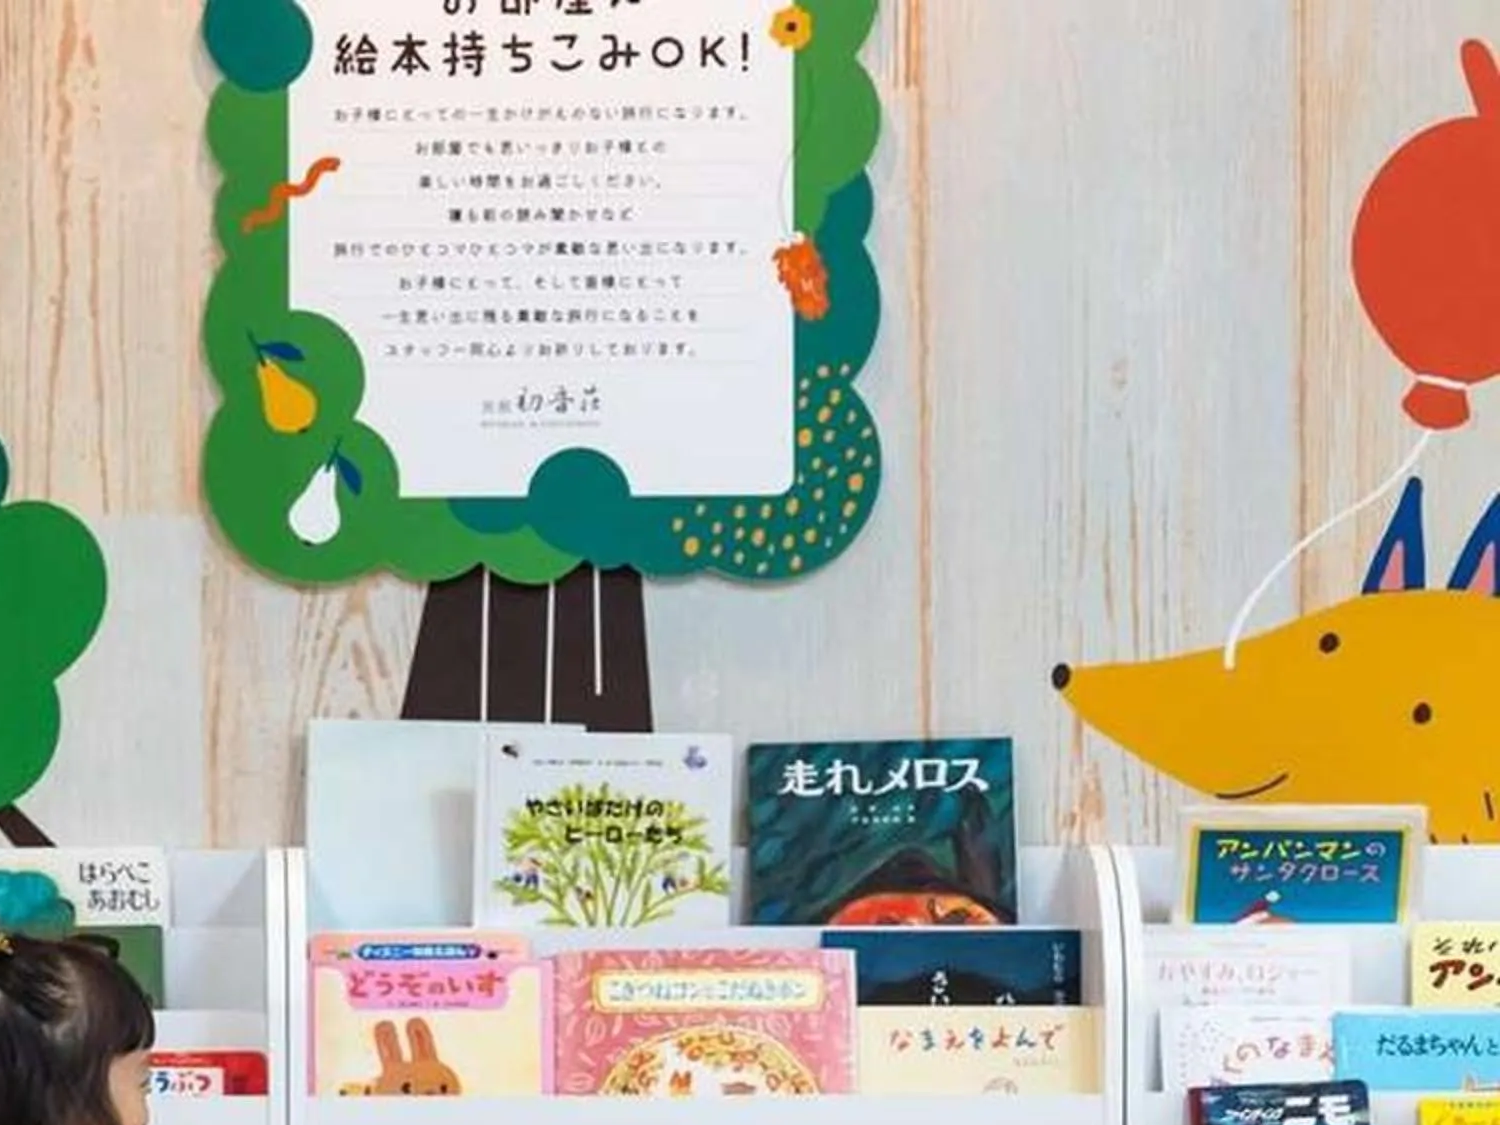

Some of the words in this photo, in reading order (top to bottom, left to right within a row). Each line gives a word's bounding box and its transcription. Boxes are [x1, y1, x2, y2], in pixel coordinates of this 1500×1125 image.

[333, 30, 749, 77] 絵本持ちこみOK!
[777, 758, 990, 796] 走れメロス
[526, 798, 666, 818] やさいばたけの
[565, 825, 684, 844] ヒーローたち
[1215, 838, 1387, 860] アンパンマンの
[78, 861, 152, 884] はらぺこ
[1230, 861, 1381, 883] サンタクロース
[87, 888, 160, 911] あおむし
[349, 968, 507, 999] どうぞのいす
[1429, 958, 1500, 991] アン
[890, 1024, 1065, 1052] なまえをよんで
